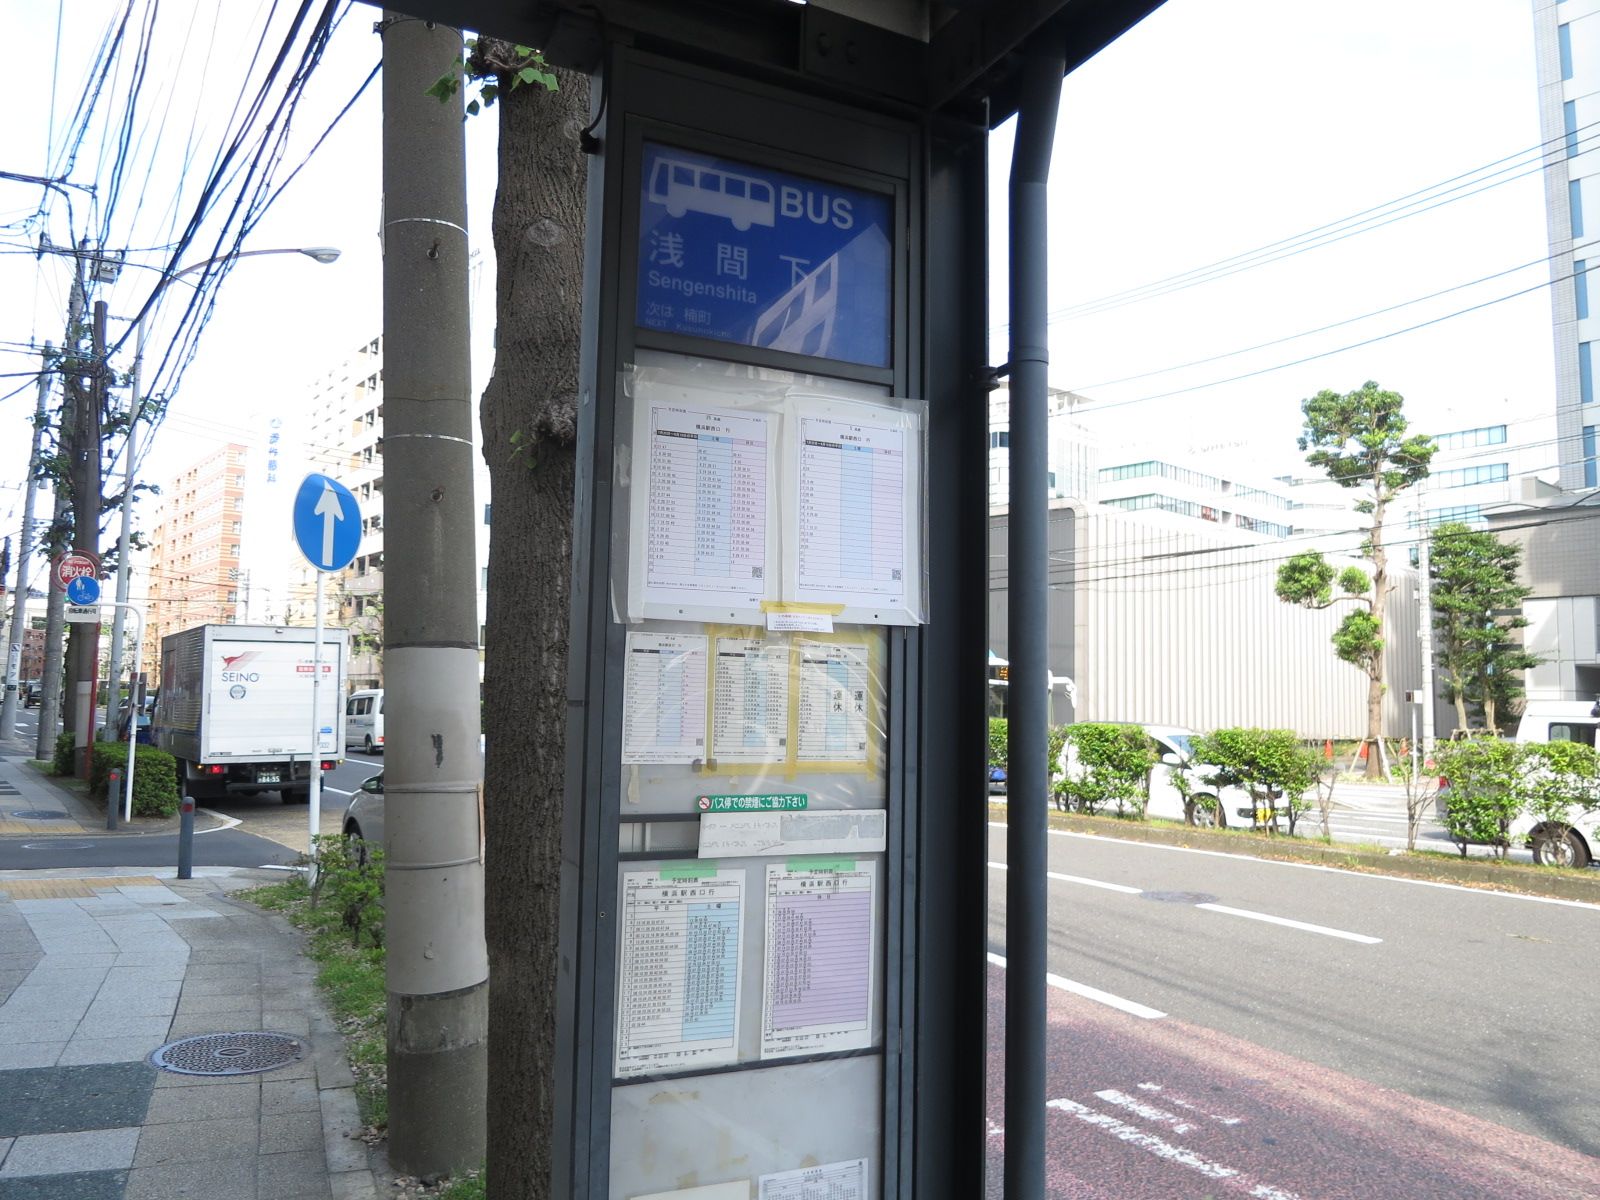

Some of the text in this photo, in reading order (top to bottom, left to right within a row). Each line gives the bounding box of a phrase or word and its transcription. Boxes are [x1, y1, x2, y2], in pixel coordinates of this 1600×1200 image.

[781, 185, 854, 230] BUS
[648, 230, 811, 288] 浅間下
[648, 271, 758, 304] Sengenshita
[645, 302, 712, 325] 次は 楠町
[62, 565, 92, 577] 消火栓
[221, 672, 260, 683] SEINO
[710, 796, 806, 809] バス停での禁煙にご協力下さい
